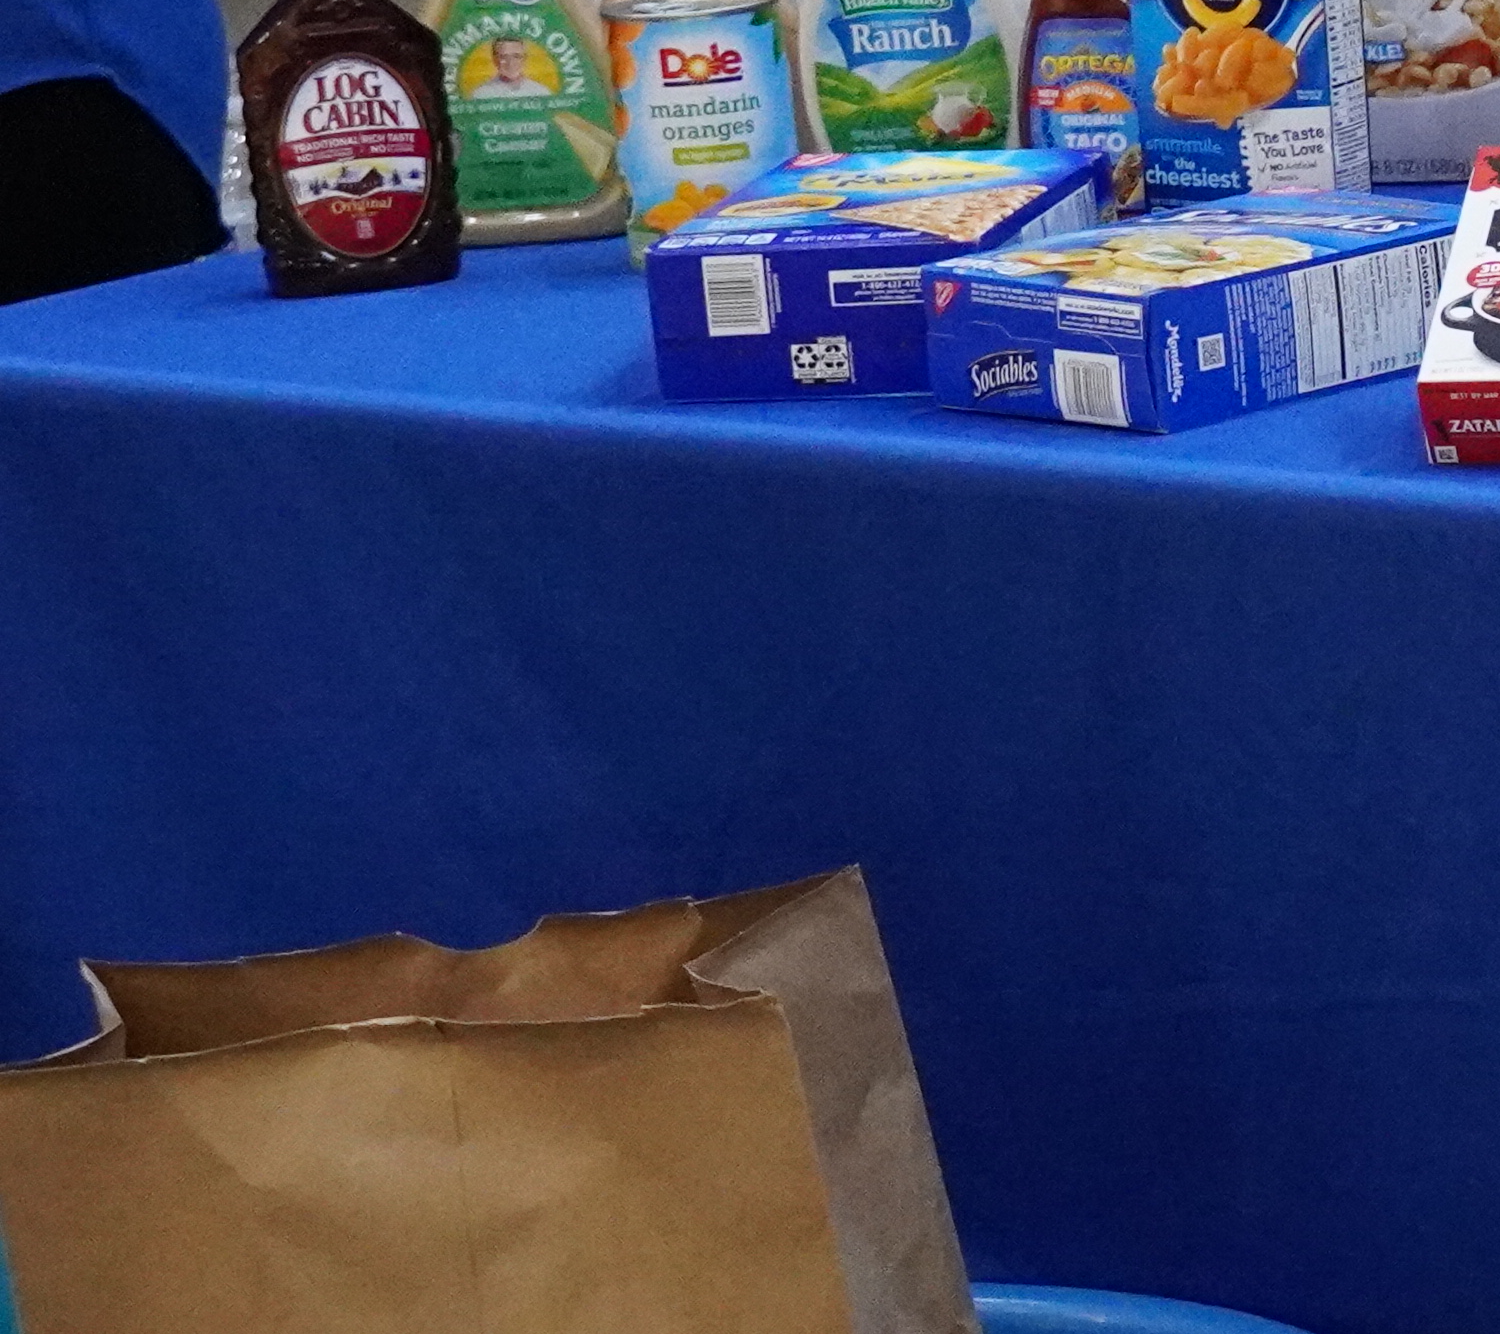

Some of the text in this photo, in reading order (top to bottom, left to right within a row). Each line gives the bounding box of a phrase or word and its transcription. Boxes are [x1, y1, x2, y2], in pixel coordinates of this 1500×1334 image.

[849, 20, 956, 54] Ranch
[546, 31, 586, 96] OWN
[660, 43, 743, 80] Dole
[313, 71, 381, 104] LOG
[303, 100, 404, 134] CABIN
[650, 91, 762, 119] mandarin
[662, 116, 755, 143] oranges
[1064, 132, 1127, 153] TACO
[1253, 127, 1325, 145] The Taste
[293, 135, 359, 154] TRADITIONAL
[1261, 141, 1324, 158] You Love
[1145, 167, 1241, 190] cheesiest
[332, 197, 392, 215] Original
[970, 355, 1039, 397] Sociables
